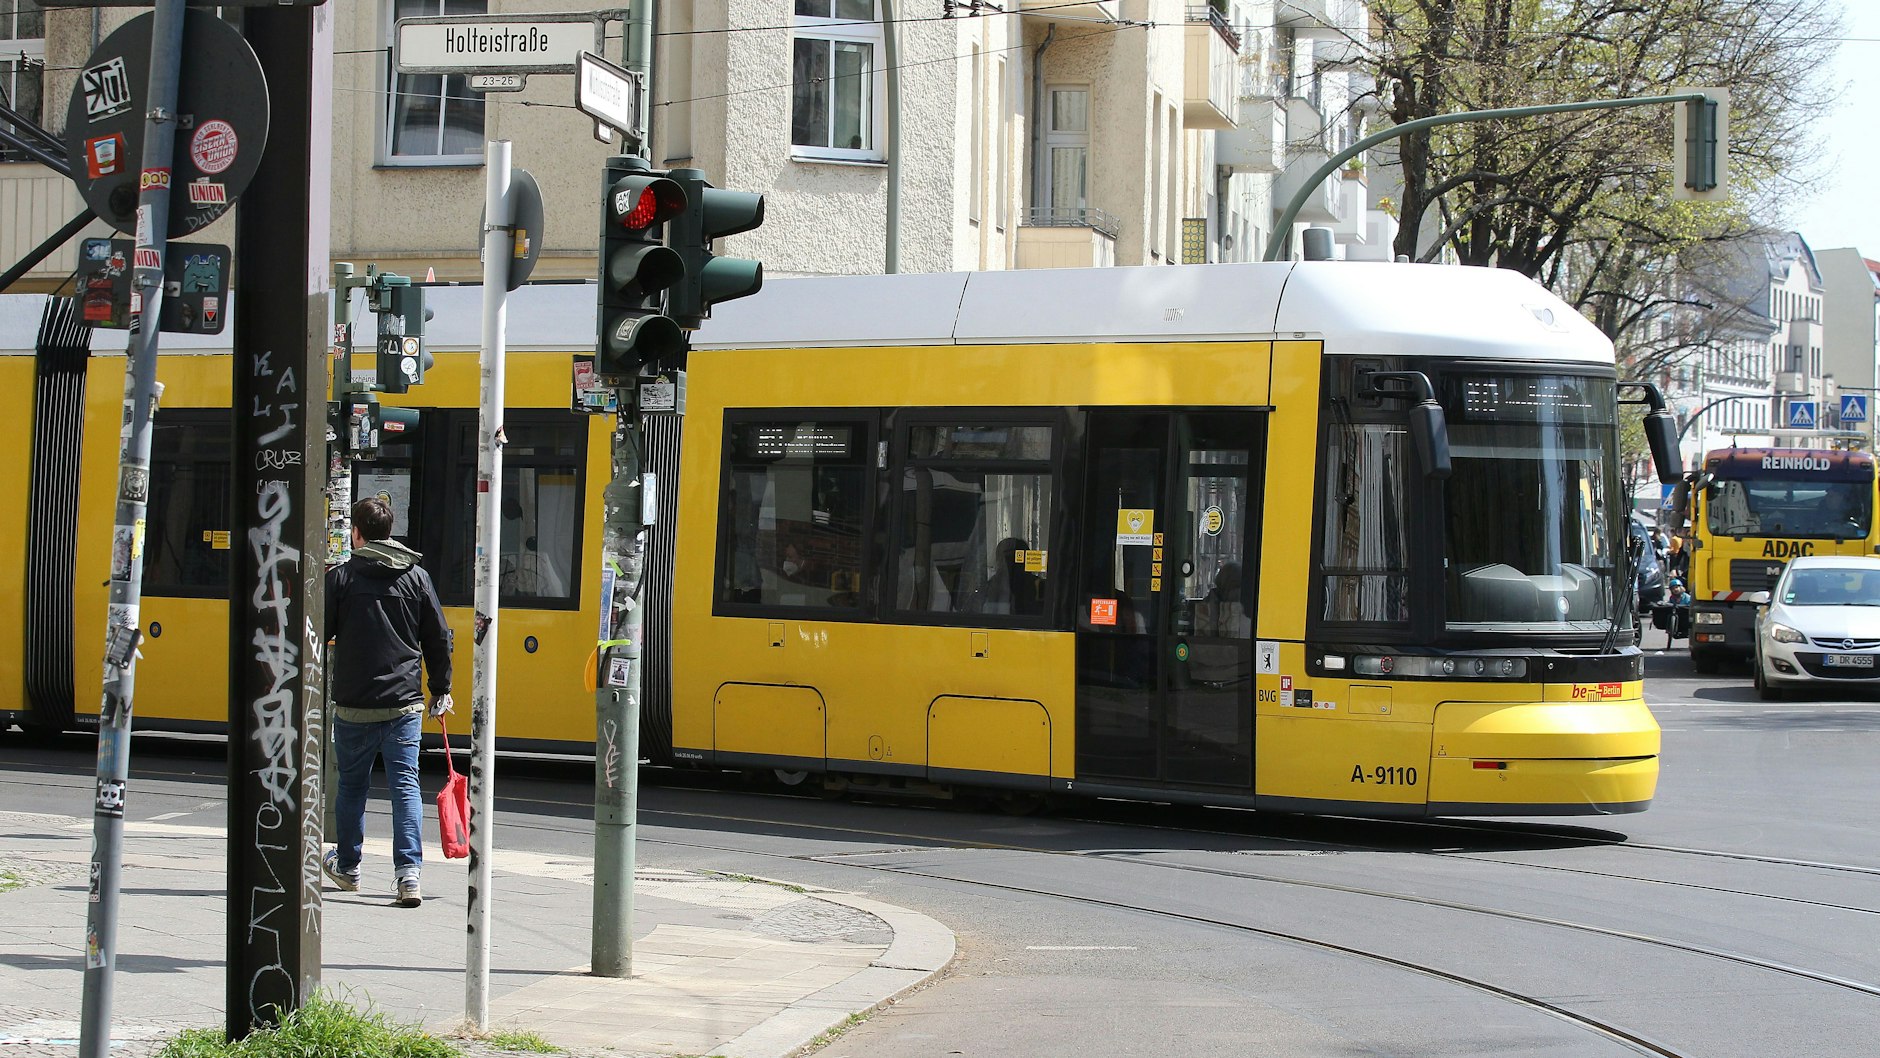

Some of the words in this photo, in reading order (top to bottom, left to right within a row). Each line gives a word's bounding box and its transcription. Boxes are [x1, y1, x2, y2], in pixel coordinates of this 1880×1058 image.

[446, 27, 548, 53] Holteistraße
[482, 76, 514, 86] 23-26
[193, 132, 227, 154] EISERN
[207, 142, 236, 161] UNION
[191, 185, 225, 202] UNION
[134, 250, 161, 269] NION
[1762, 456, 1831, 471] REINHOLD
[1762, 540, 1814, 558] ADAC
[1258, 689, 1277, 702] BVG
[1603, 685, 1621, 695] Berlin
[1350, 764, 1418, 786] A-9110
